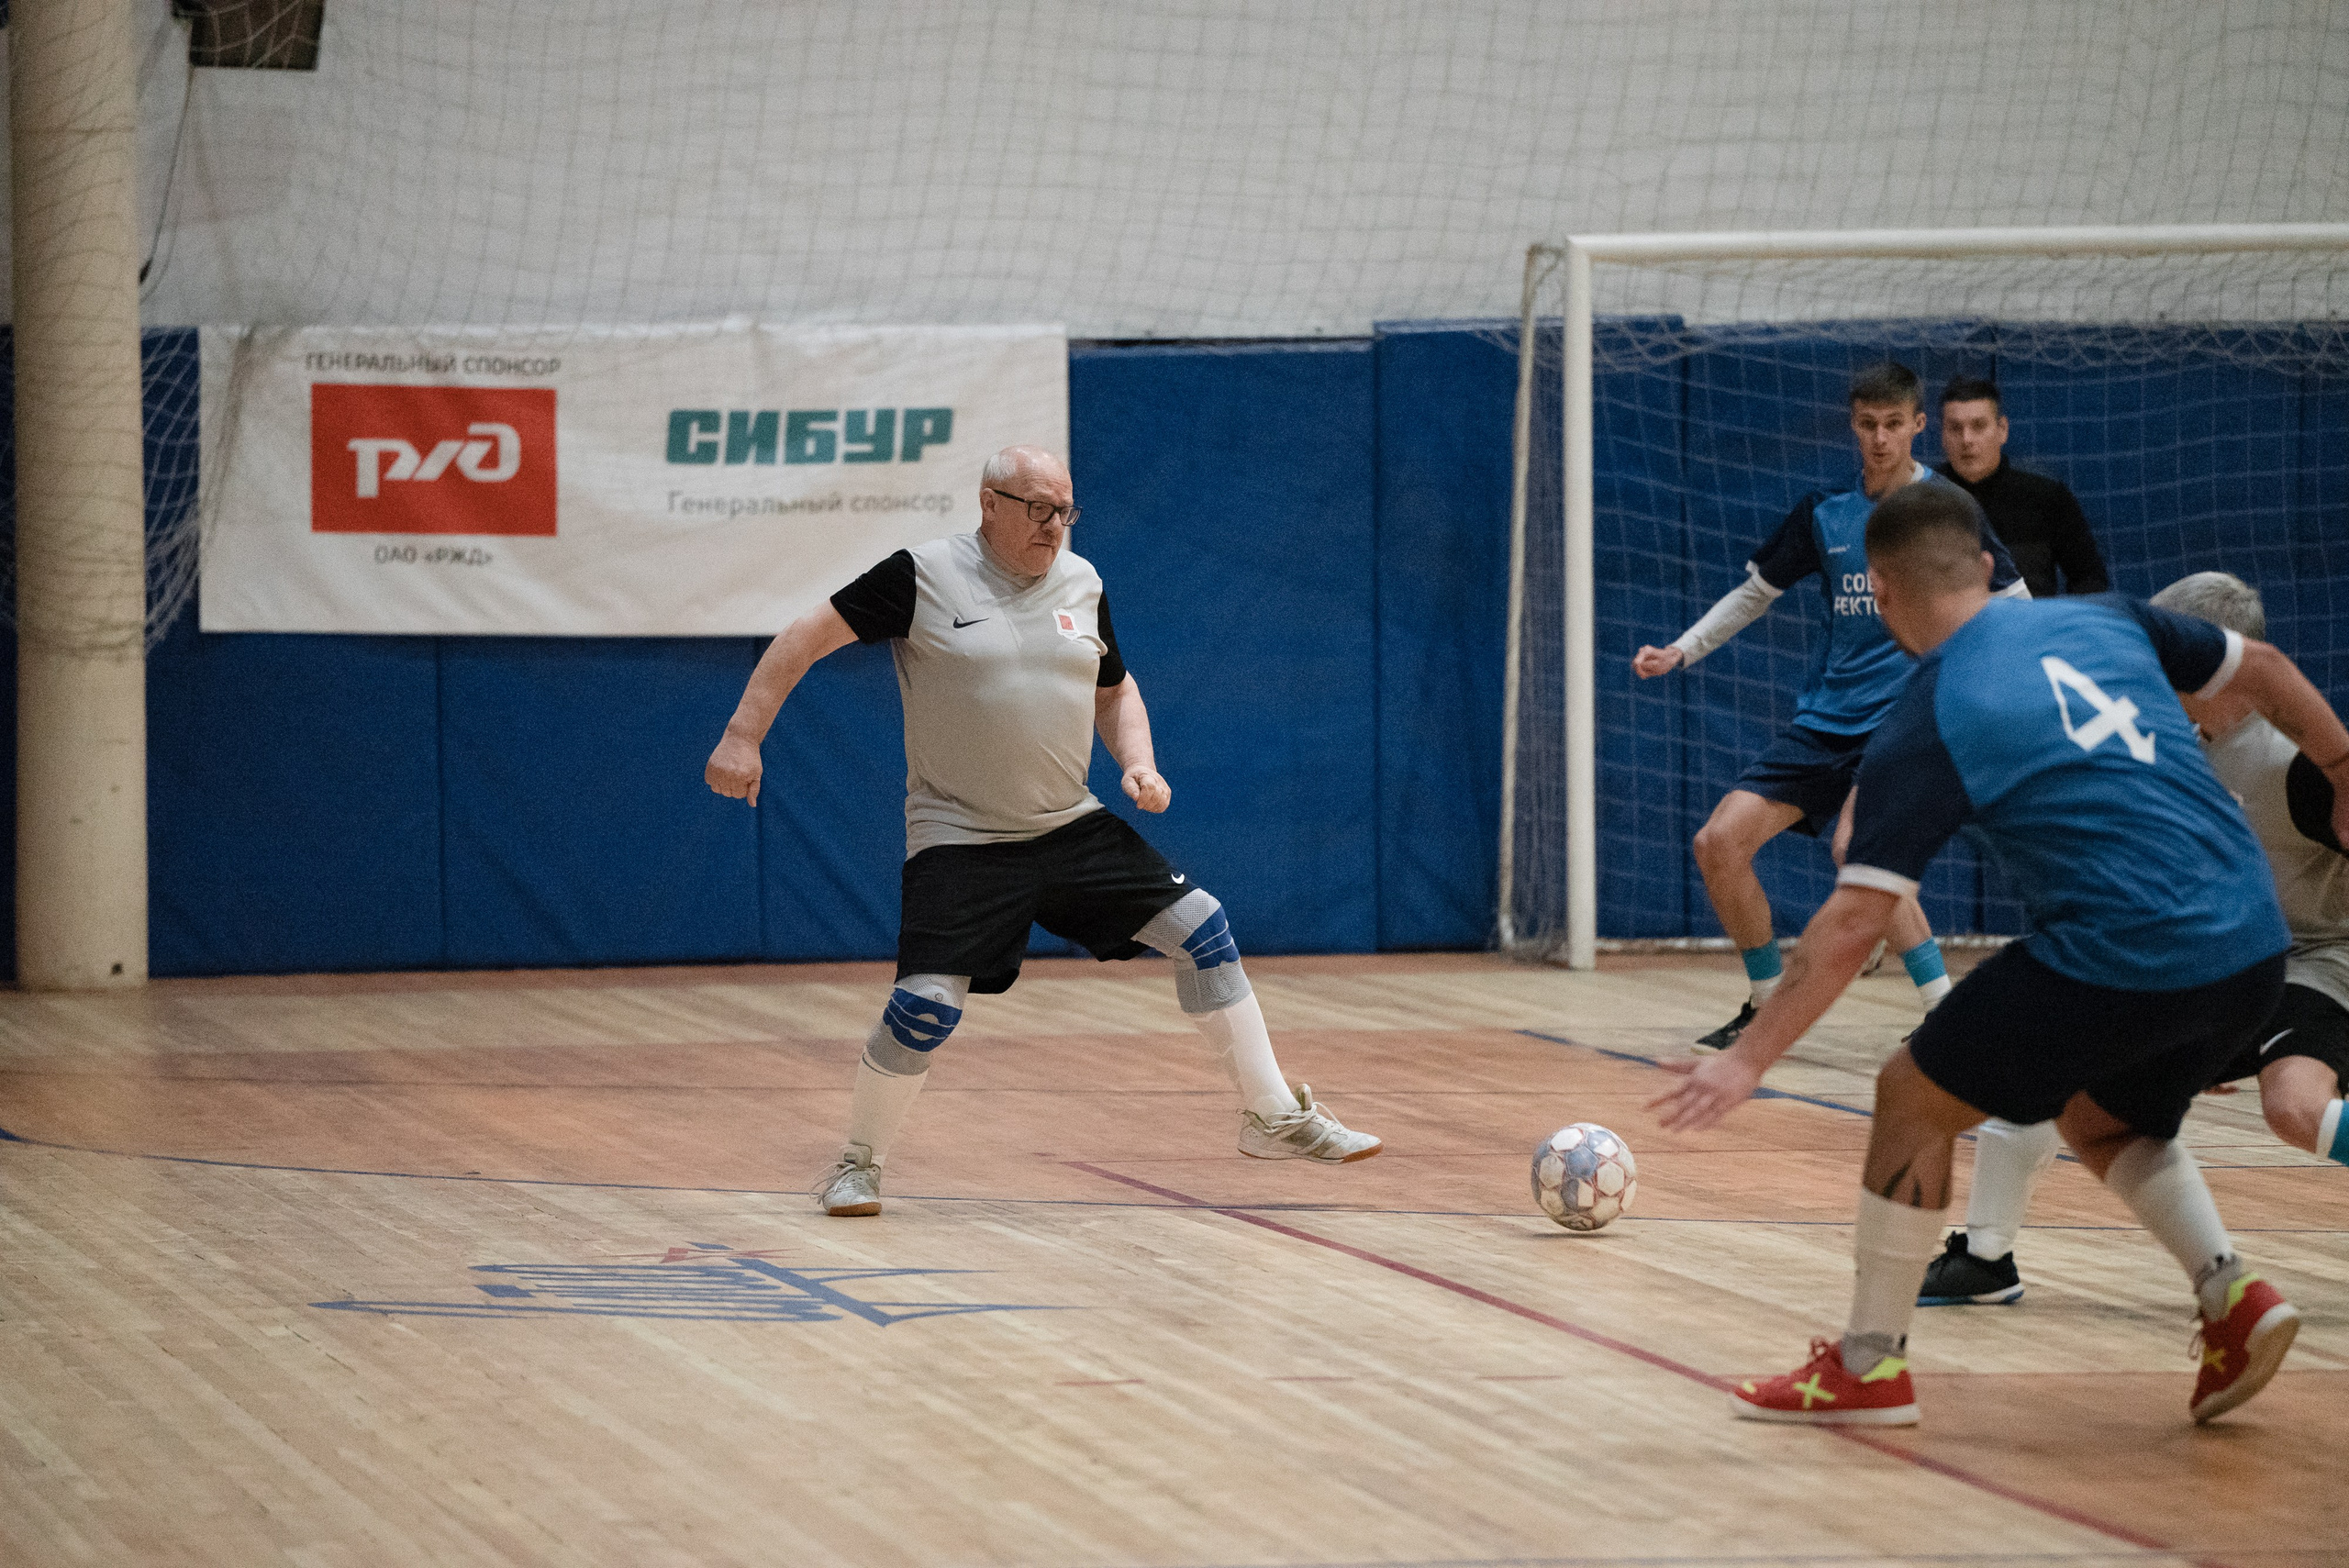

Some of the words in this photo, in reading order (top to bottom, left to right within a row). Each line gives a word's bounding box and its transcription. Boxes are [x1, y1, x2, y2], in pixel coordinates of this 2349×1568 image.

[306, 352, 456, 374] ГЕНЕРАЛЬНЫЙ
[463, 356, 561, 377] СПОНСОР
[666, 407, 954, 464] СИБУР
[668, 490, 843, 519] Генеральный
[850, 494, 954, 517] спонсор
[373, 546, 418, 564] ОАО
[2041, 656, 2156, 764] 4
